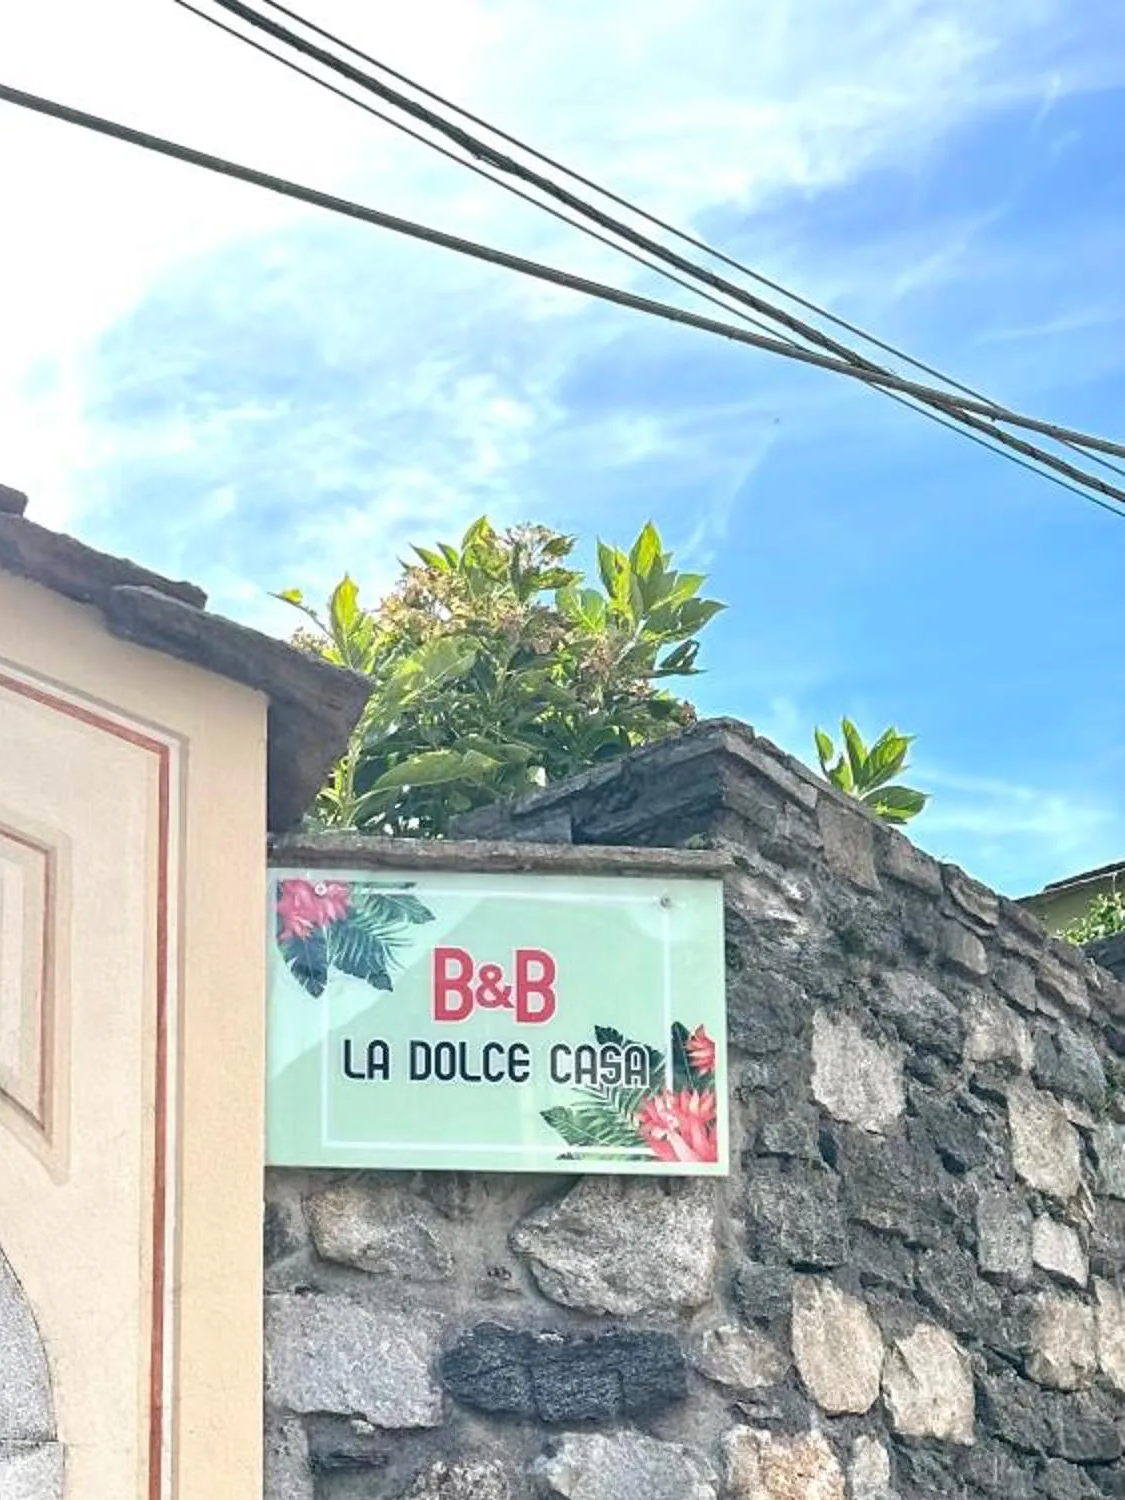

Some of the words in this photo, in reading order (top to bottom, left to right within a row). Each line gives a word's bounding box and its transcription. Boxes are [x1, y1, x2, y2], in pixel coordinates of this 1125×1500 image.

[432, 946, 557, 1024] B&B
[344, 1039, 390, 1081] LA
[410, 1040, 531, 1082] DOLCE
[550, 1043, 650, 1087] CASA
